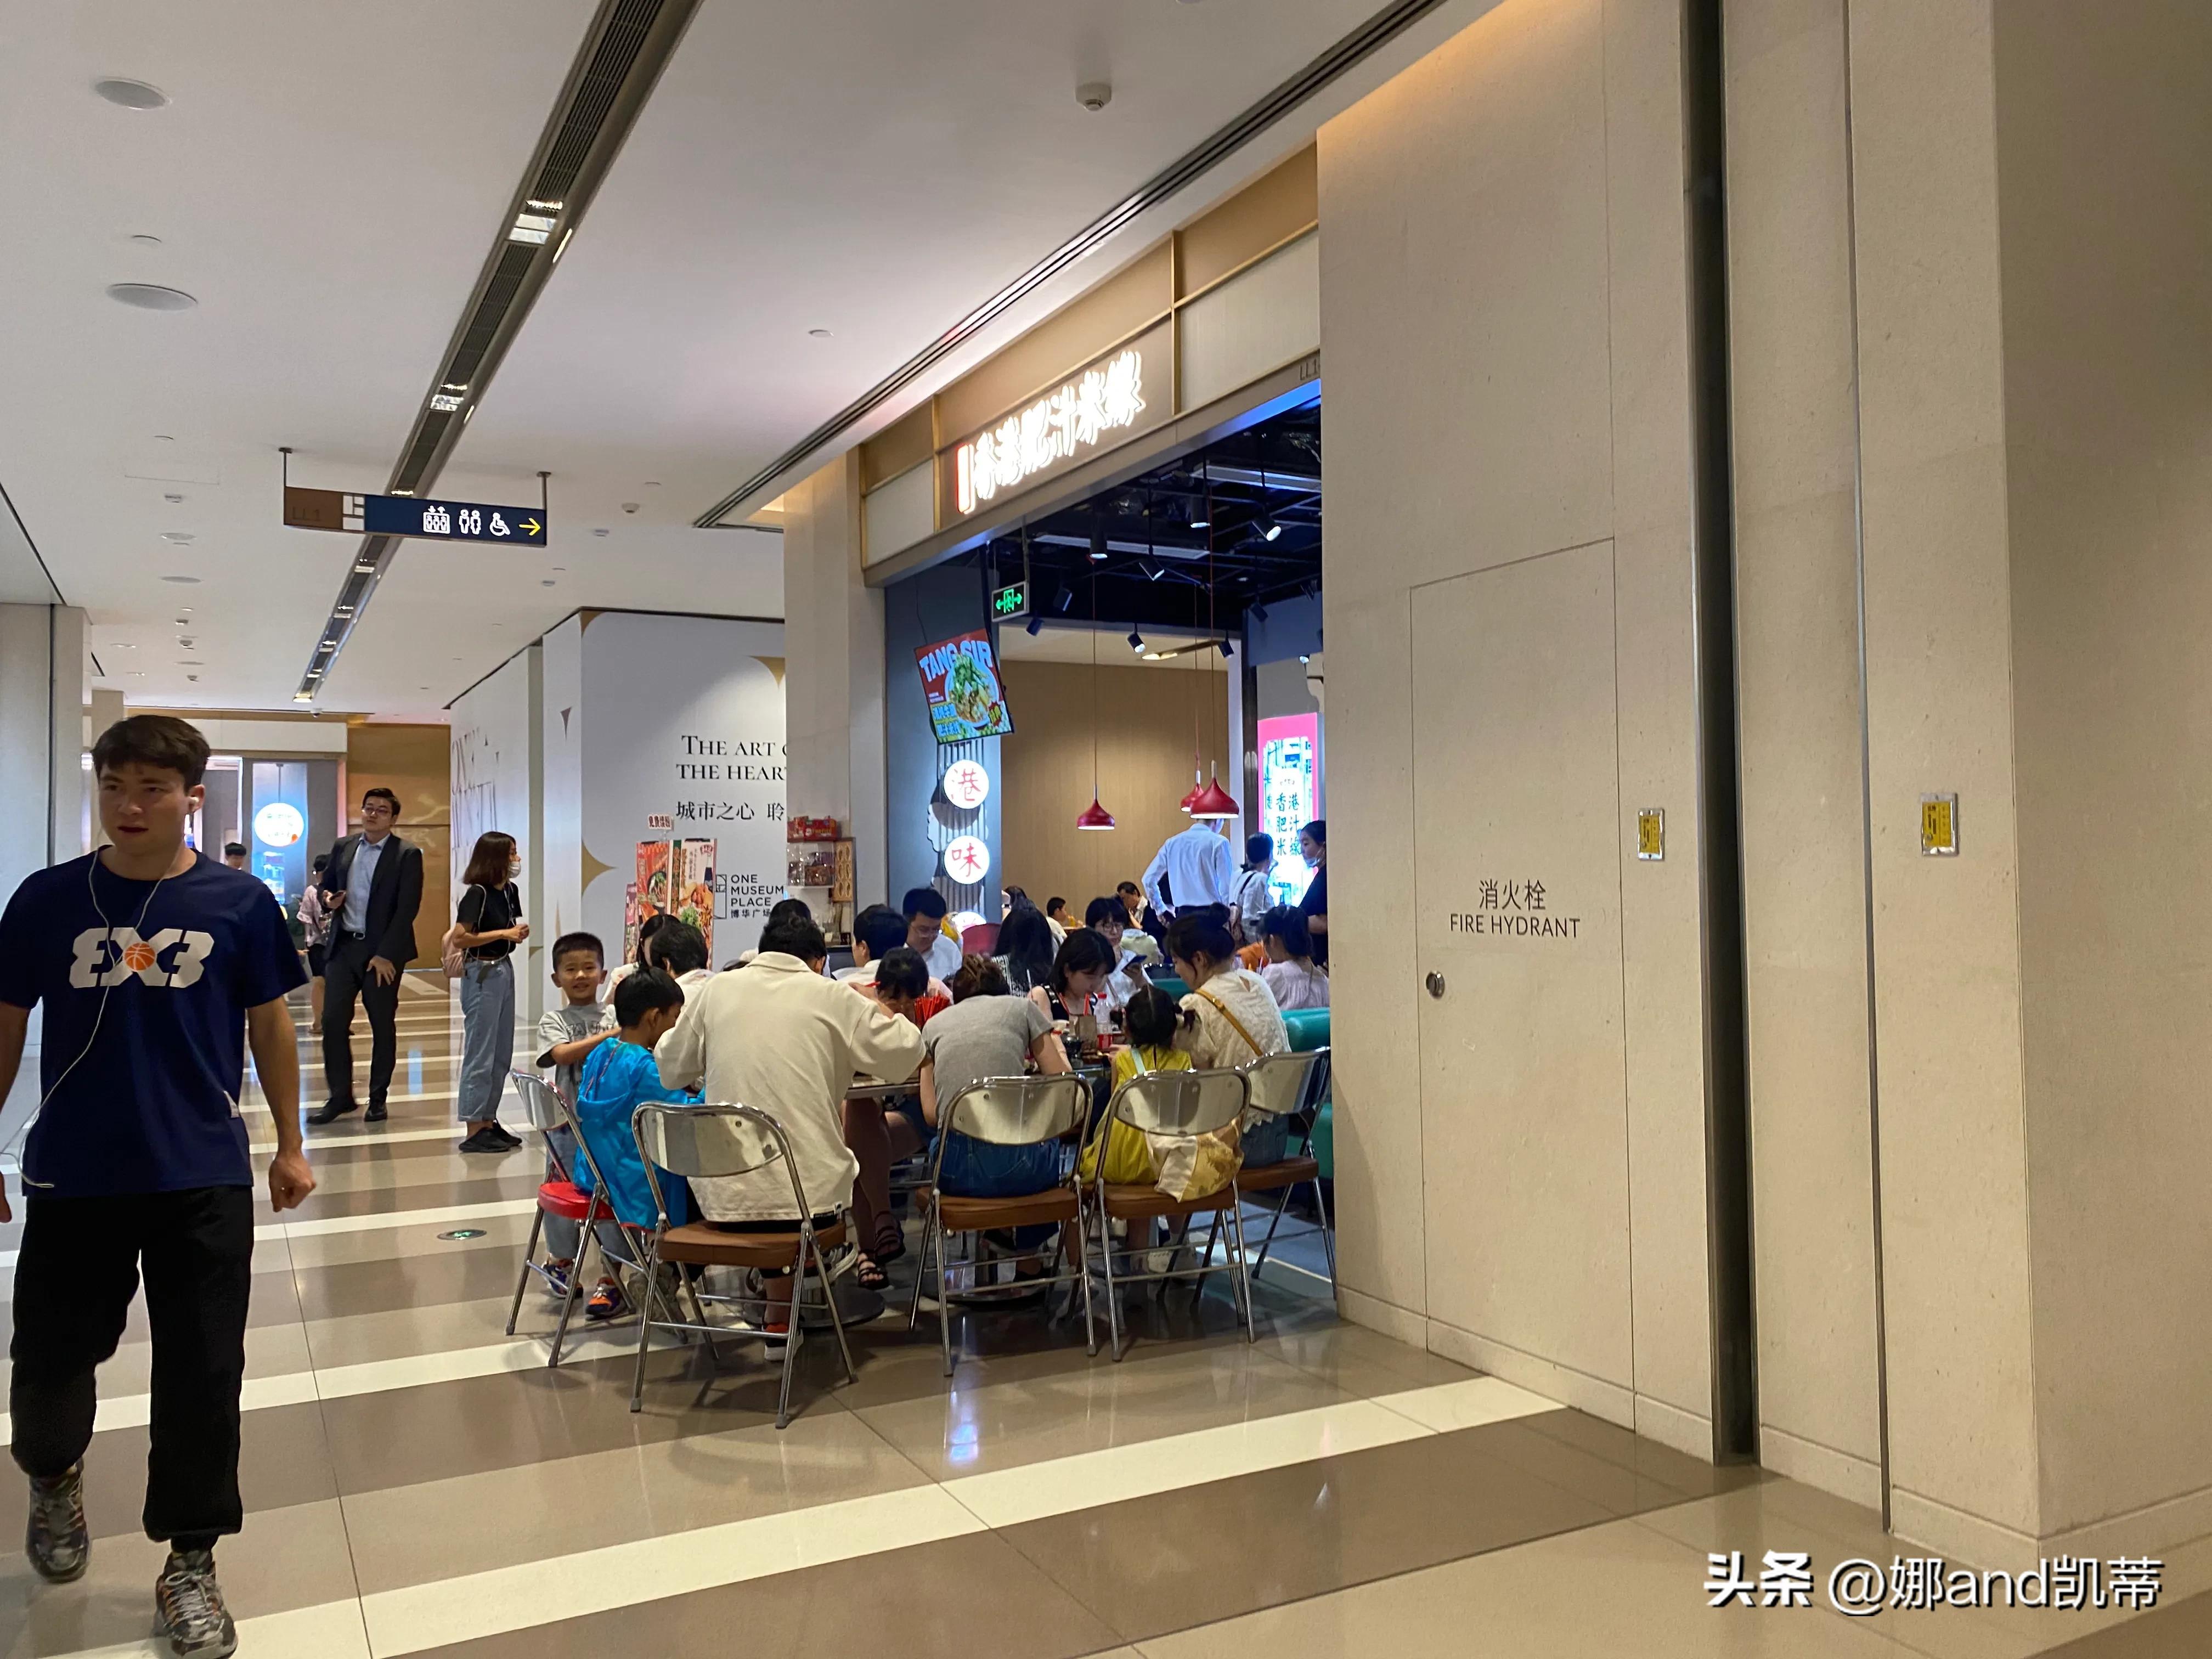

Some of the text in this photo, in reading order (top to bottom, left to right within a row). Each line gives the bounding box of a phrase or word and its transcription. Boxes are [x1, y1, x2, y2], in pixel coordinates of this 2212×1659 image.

[919, 640, 994, 682] TANG SIR
[681, 735, 727, 756] THE
[735, 741, 776, 757] ART
[675, 764, 787, 781] THE HEAR
[675, 801, 755, 821] 城市之心
[1276, 792, 1300, 812] 香港
[1276, 814, 1300, 833] 肥汁
[951, 842, 982, 877] 味
[731, 874, 758, 884] ONE
[731, 885, 784, 895] MUSEUM
[1479, 878, 1546, 911] 消火栓
[731, 897, 771, 907] PLACE
[1450, 913, 1581, 939] FIRE HYDRANT
